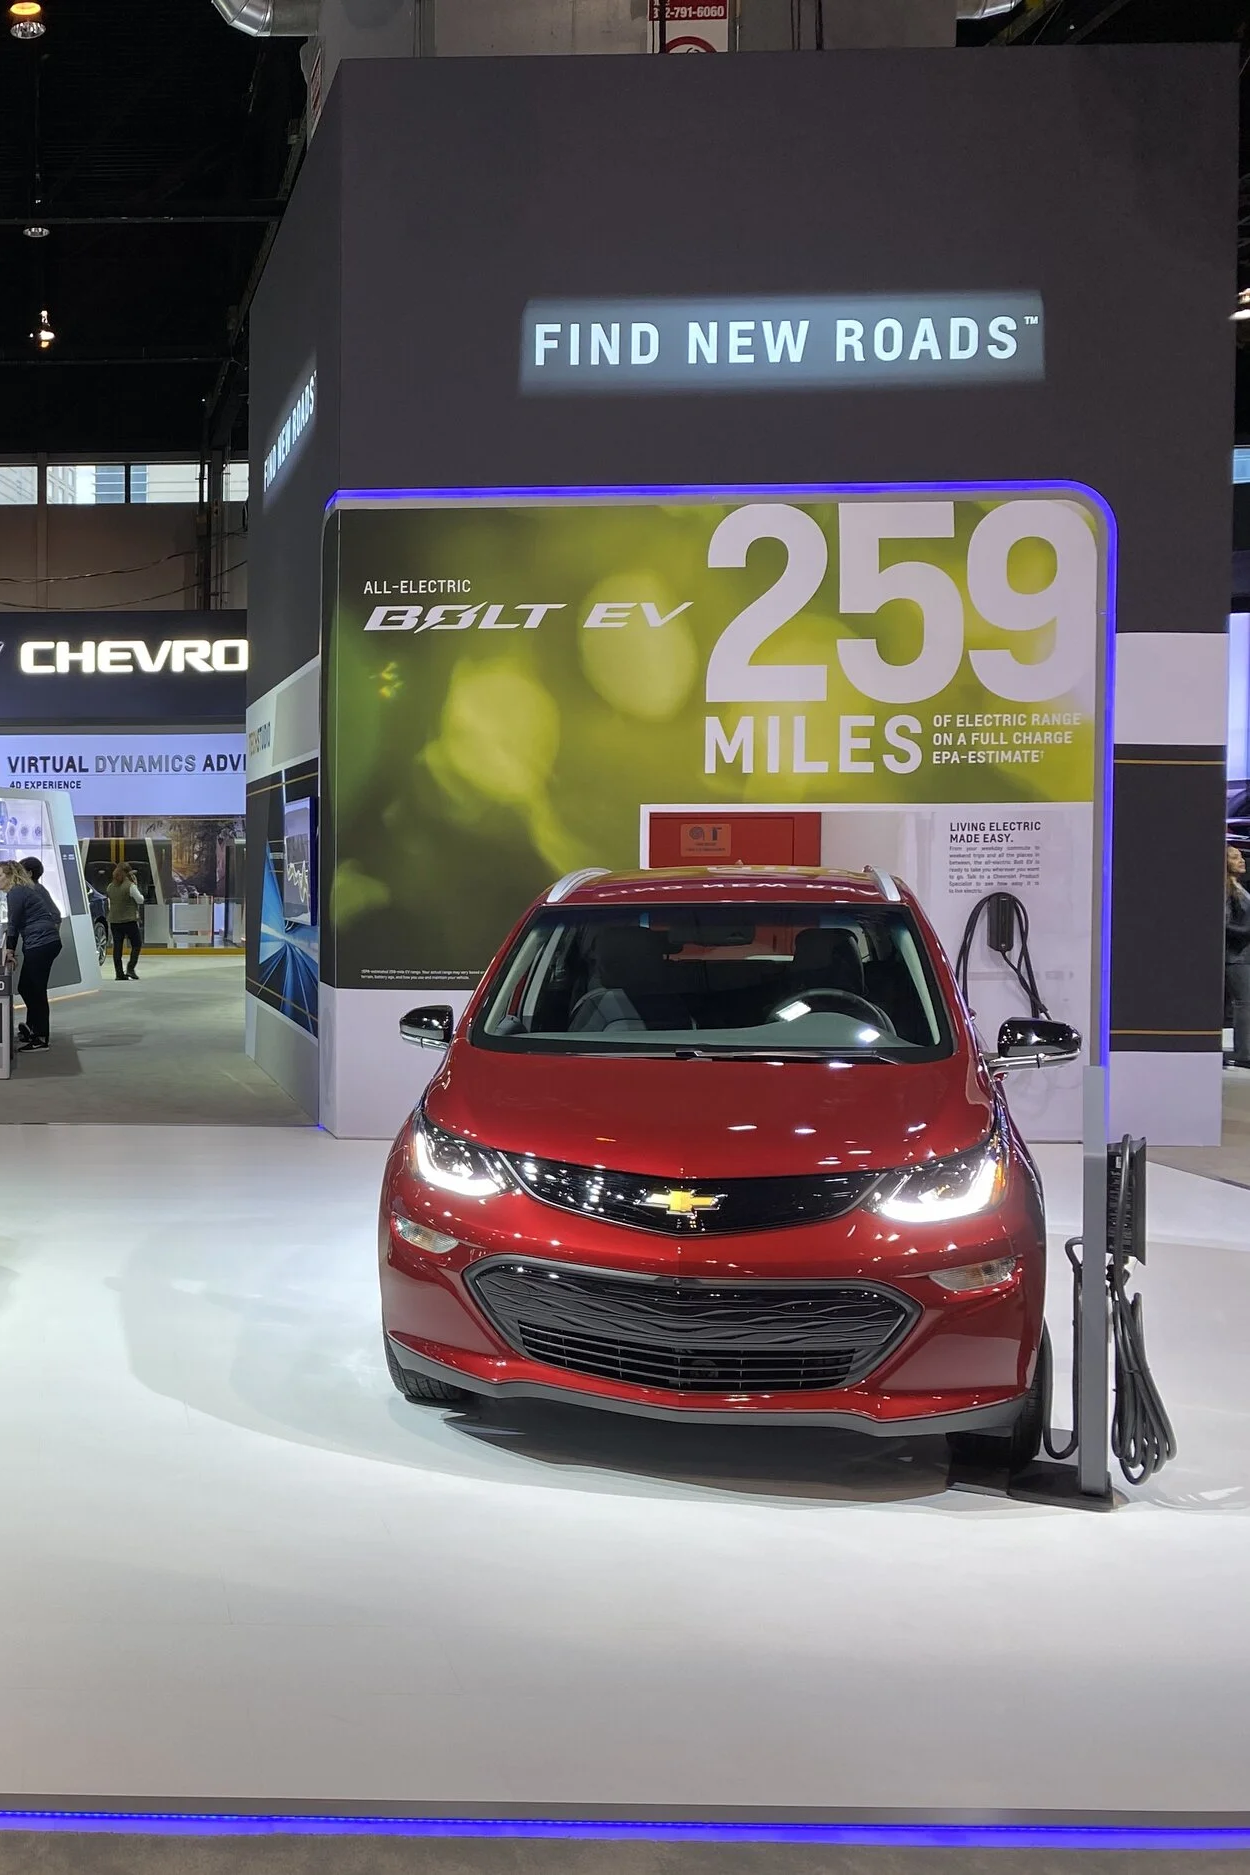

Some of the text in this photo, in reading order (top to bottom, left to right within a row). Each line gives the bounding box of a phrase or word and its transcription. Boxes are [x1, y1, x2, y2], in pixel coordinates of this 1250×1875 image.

[653, 6, 724, 18] 32-791-6060
[535, 323, 660, 366] FIND
[688, 320, 809, 364] NEW
[363, 579, 471, 595] ALL-ELECTRIC
[706, 500, 1097, 703] 259
[363, 601, 694, 634] BOLT EV
[20, 639, 249, 673] CHEVRO
[933, 713, 1081, 727] OF ELECTRIC RANGE
[704, 714, 923, 774] MILES
[933, 731, 1073, 746] ON A FULL CHARGE
[7, 755, 89, 774] VIRTUAL
[95, 754, 196, 773] DYNAMICS
[9, 780, 82, 789] 4D EXPERIENCE
[950, 822, 1041, 831] LIVING ELECTRIC
[950, 834, 1014, 843] MADE EASY.
